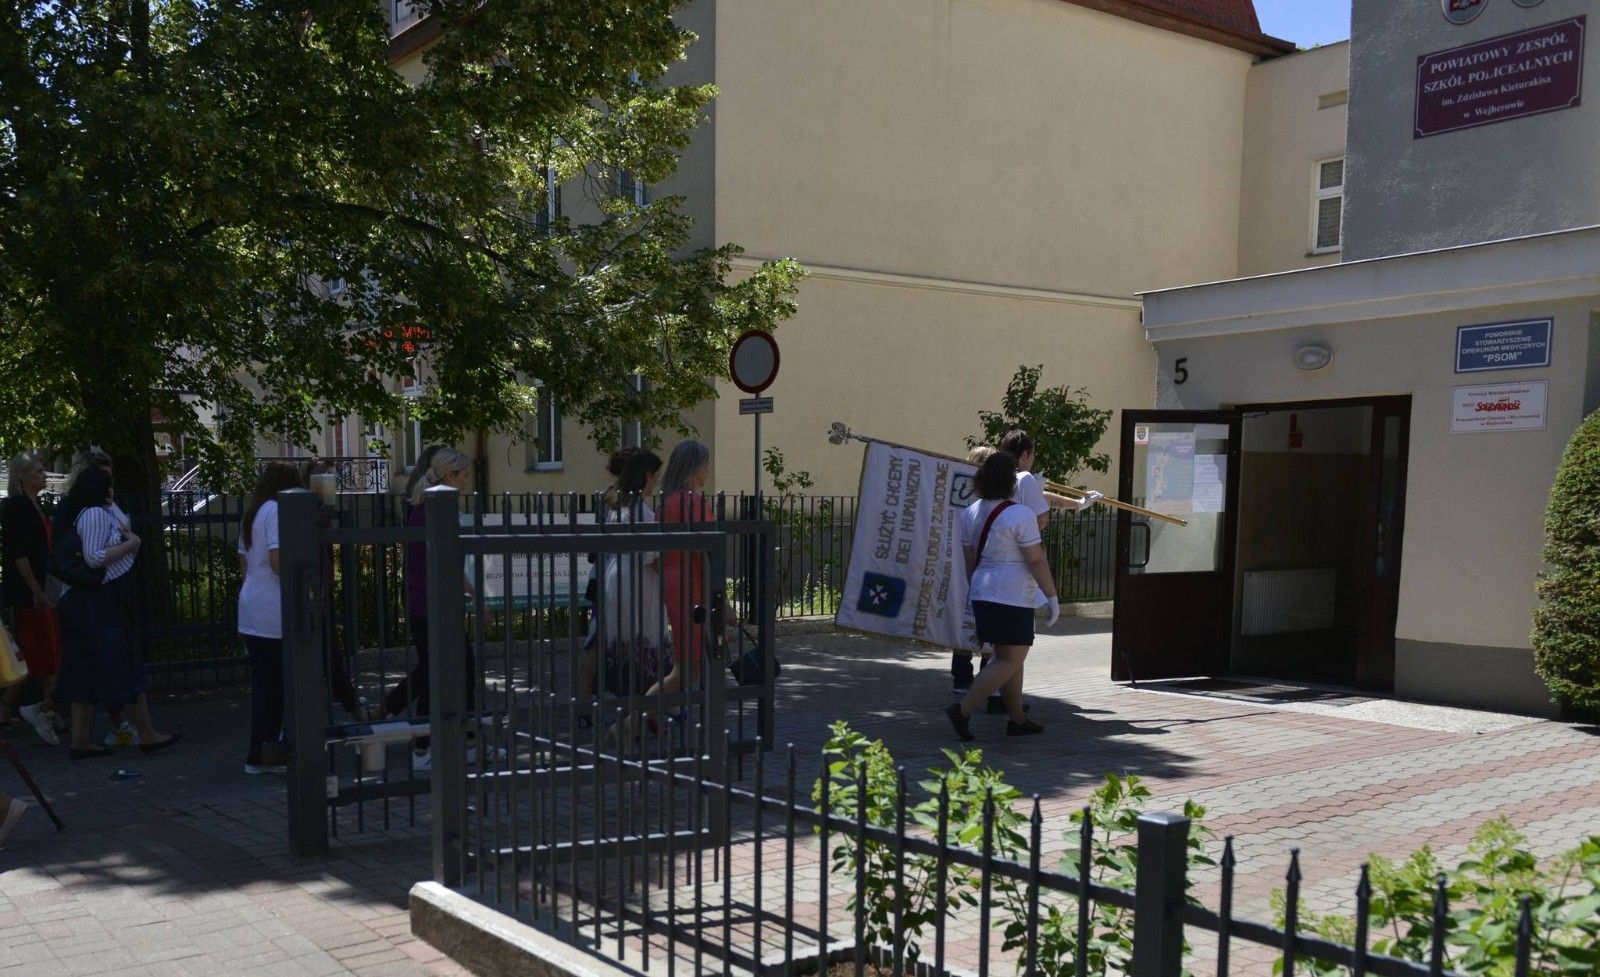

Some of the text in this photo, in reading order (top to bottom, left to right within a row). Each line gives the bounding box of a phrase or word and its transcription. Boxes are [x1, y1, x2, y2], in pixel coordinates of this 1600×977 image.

[1424, 50, 1574, 94] SZKÓŁ POLICEALNYCH
[1430, 32, 1569, 74] POWIATOWY ZESPÓŁ
[1456, 88, 1499, 104] Zdzisława
[1500, 75, 1552, 93] Kieturakisa
[1463, 100, 1525, 119] w Wejherowie
[1484, 329, 1522, 338] POMORSKIE
[1500, 342, 1546, 351] MEDYCZNYCH
[1174, 357, 1188, 385] 5
[875, 454, 903, 560] SŁUŻYĆ CHCEMY
[895, 458, 921, 564] IDEI HUMANIZMU
[931, 461, 949, 525] ZAWODOWE
[925, 526, 941, 577] STUDIUM
